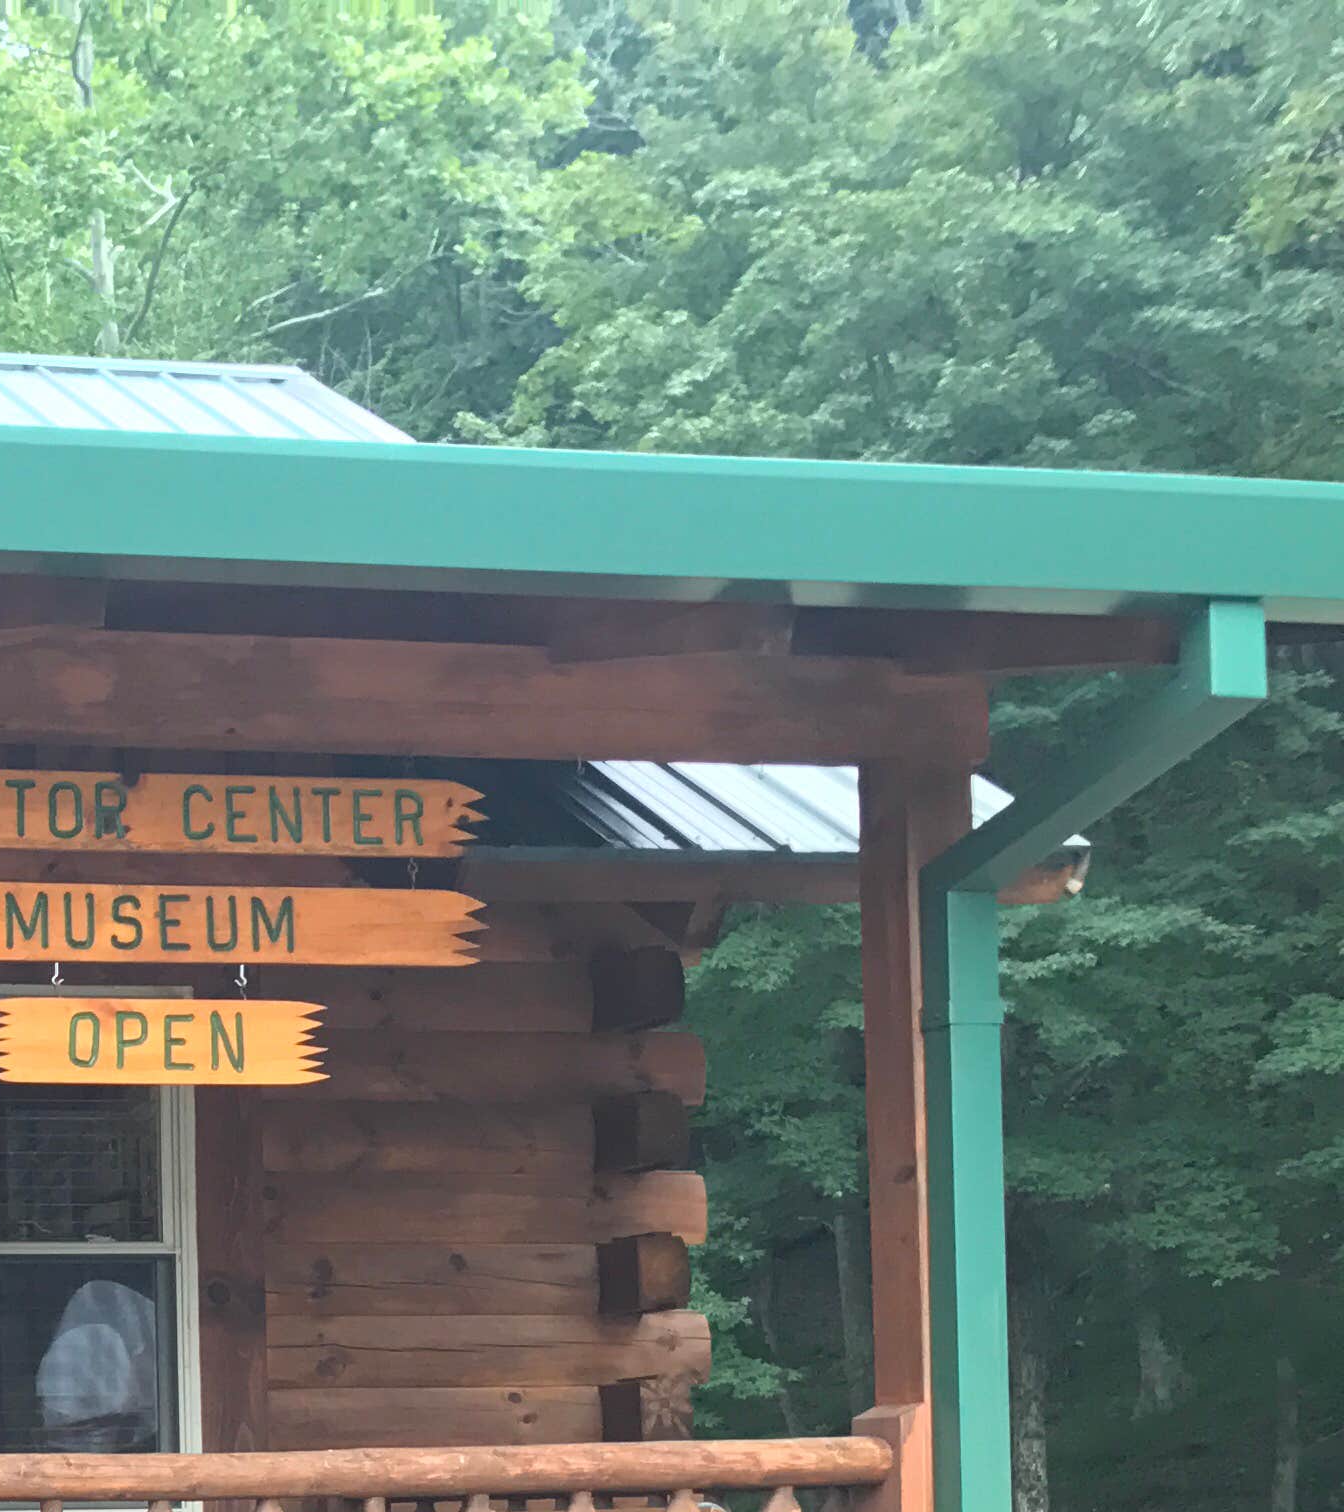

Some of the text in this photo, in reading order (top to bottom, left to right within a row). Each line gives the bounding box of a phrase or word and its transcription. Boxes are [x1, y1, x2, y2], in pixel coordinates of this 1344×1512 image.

[182, 783, 424, 846] CENTER
[4, 891, 295, 953] MUSEUM
[68, 1010, 245, 1073] OPEN
